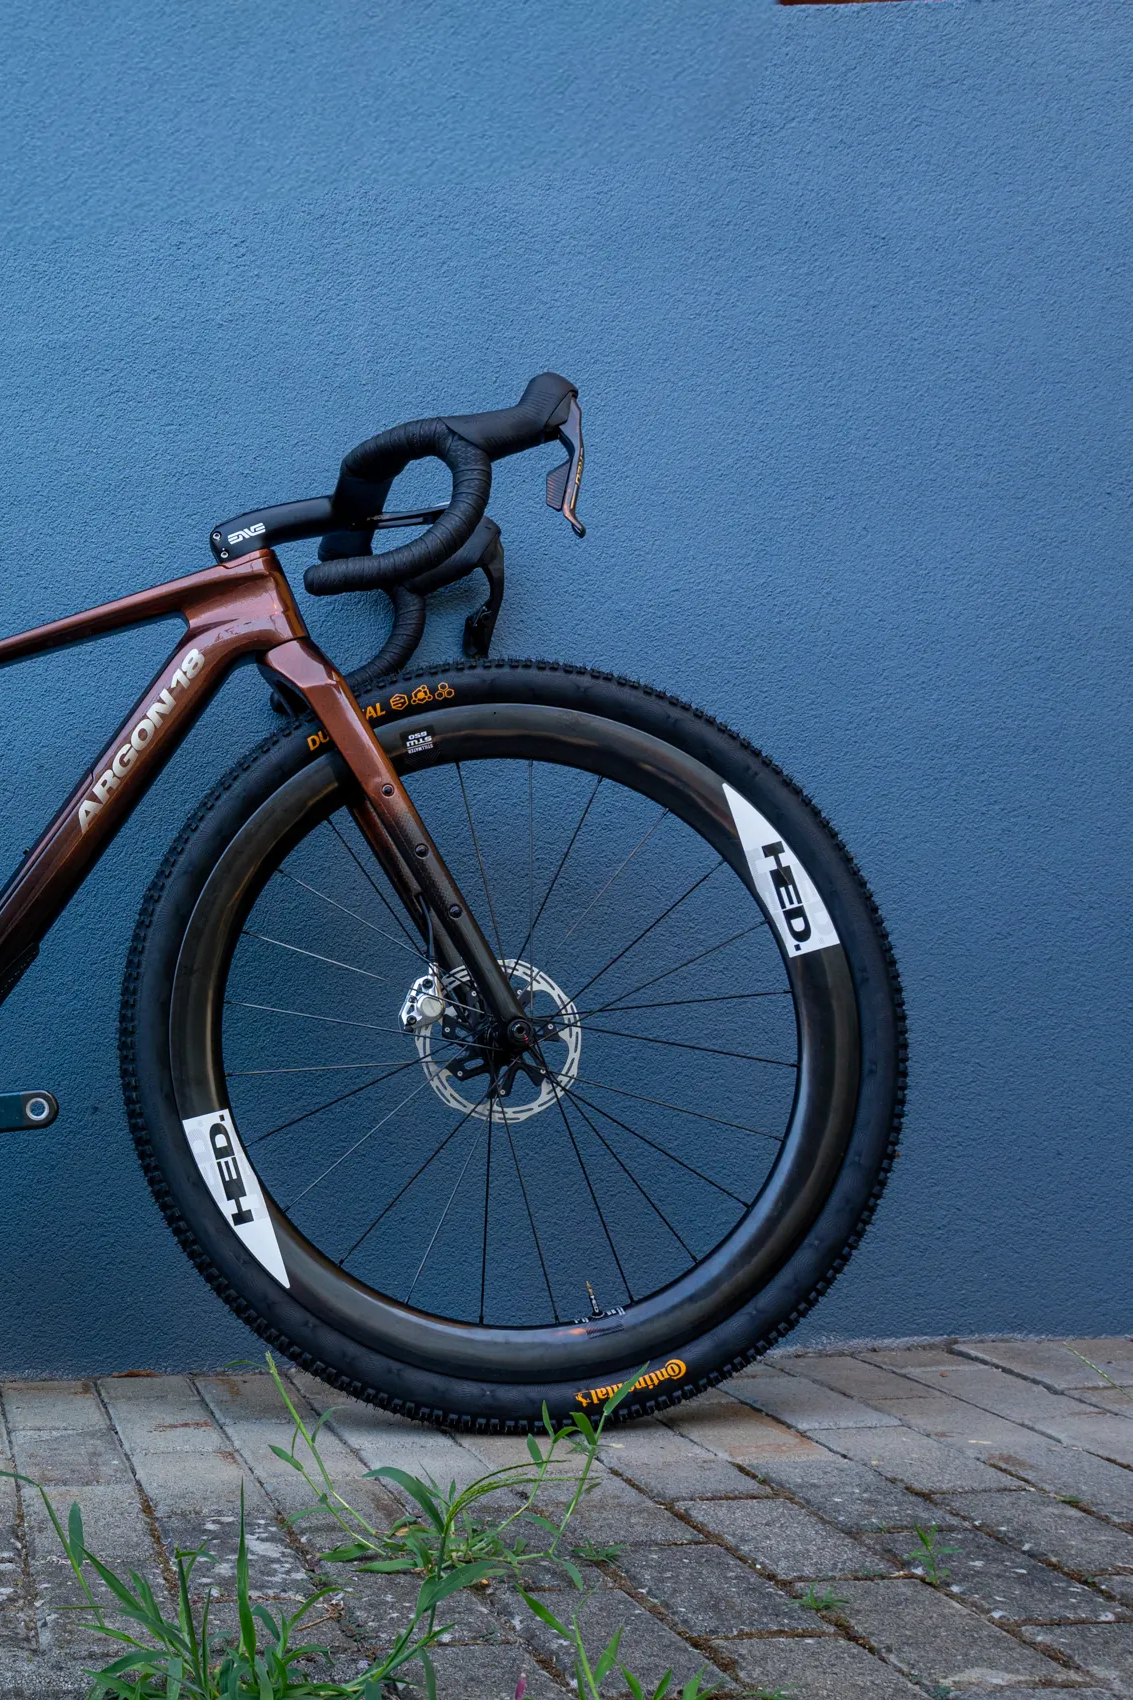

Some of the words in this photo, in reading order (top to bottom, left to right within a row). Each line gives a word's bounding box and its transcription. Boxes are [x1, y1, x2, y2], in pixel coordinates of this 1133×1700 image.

[227, 522, 266, 545] ENVE
[307, 702, 386, 751] DUAL
[408, 731, 427, 740] 650
[78, 688, 176, 833] ARGON
[170, 648, 205, 689] 18
[406, 736, 432, 747] STW
